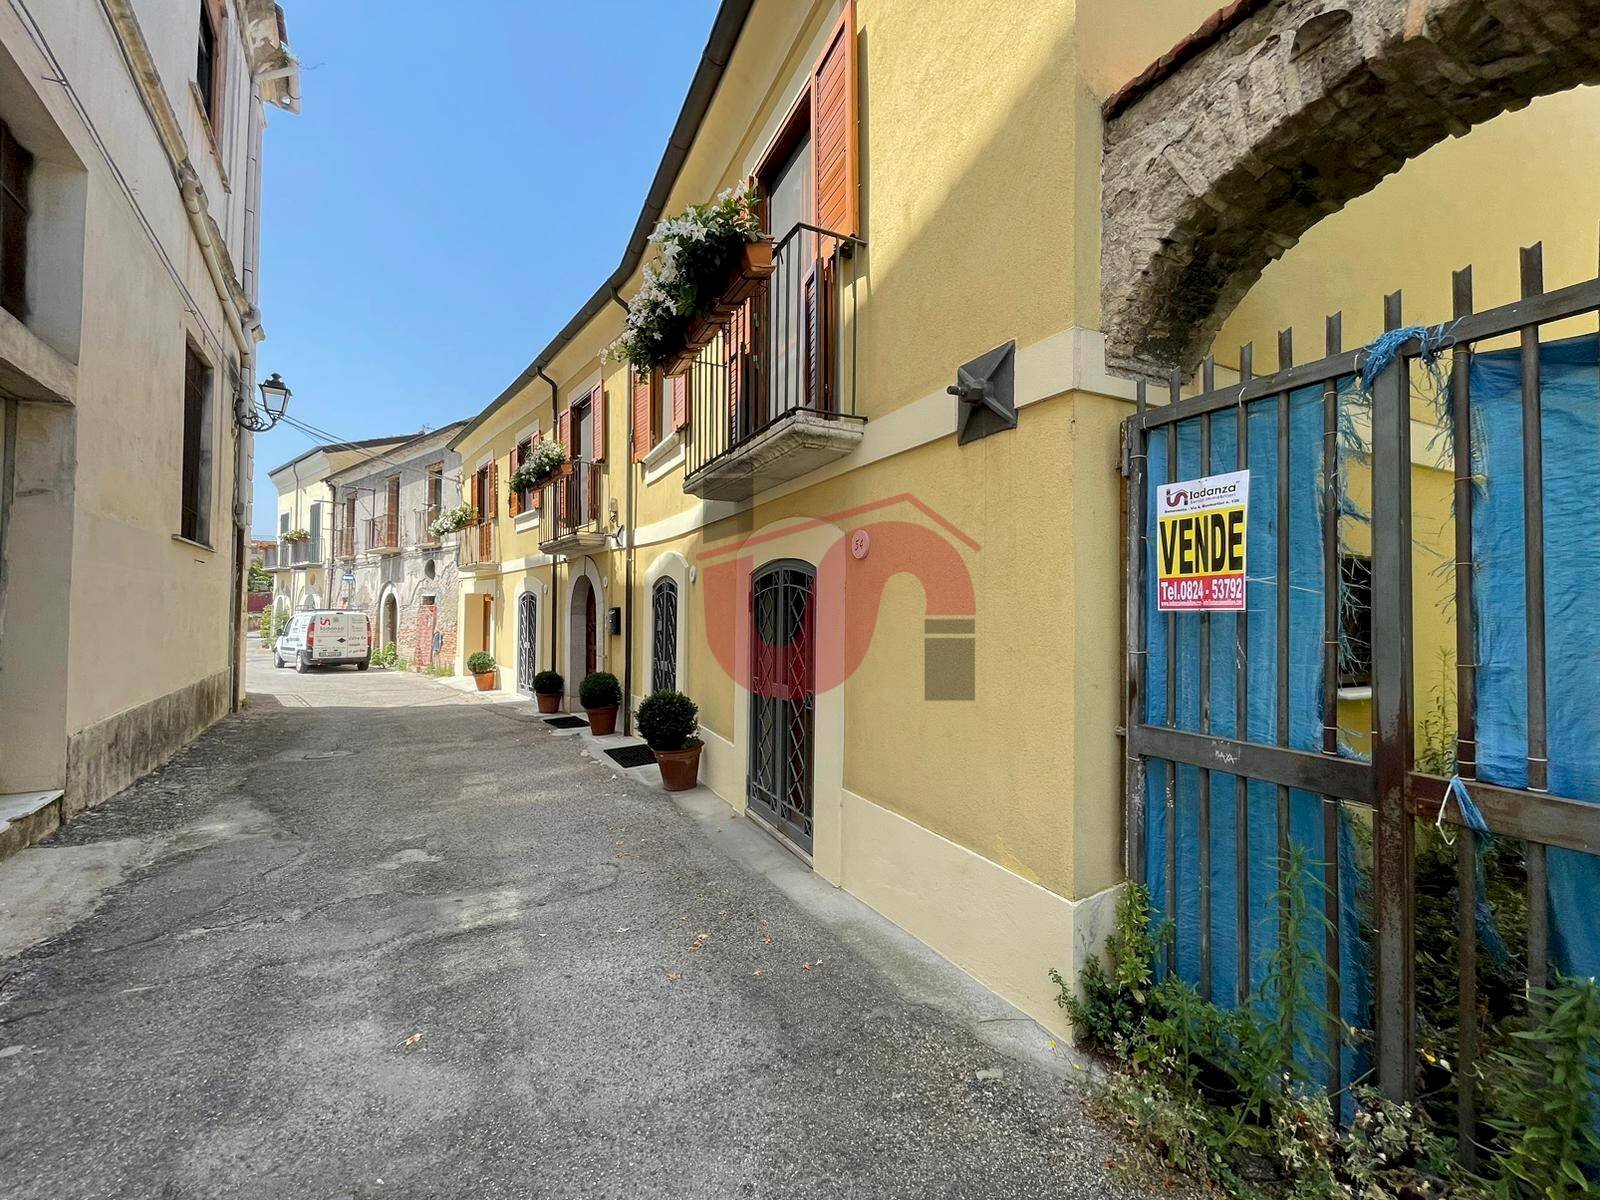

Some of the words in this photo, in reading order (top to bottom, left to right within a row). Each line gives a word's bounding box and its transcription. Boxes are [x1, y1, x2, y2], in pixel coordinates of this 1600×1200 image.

[855, 539, 864, 551] 54
[1160, 510, 1244, 575] VENDE
[1161, 579, 1203, 601] Tel.0824
[1212, 578, 1242, 600] 53792
